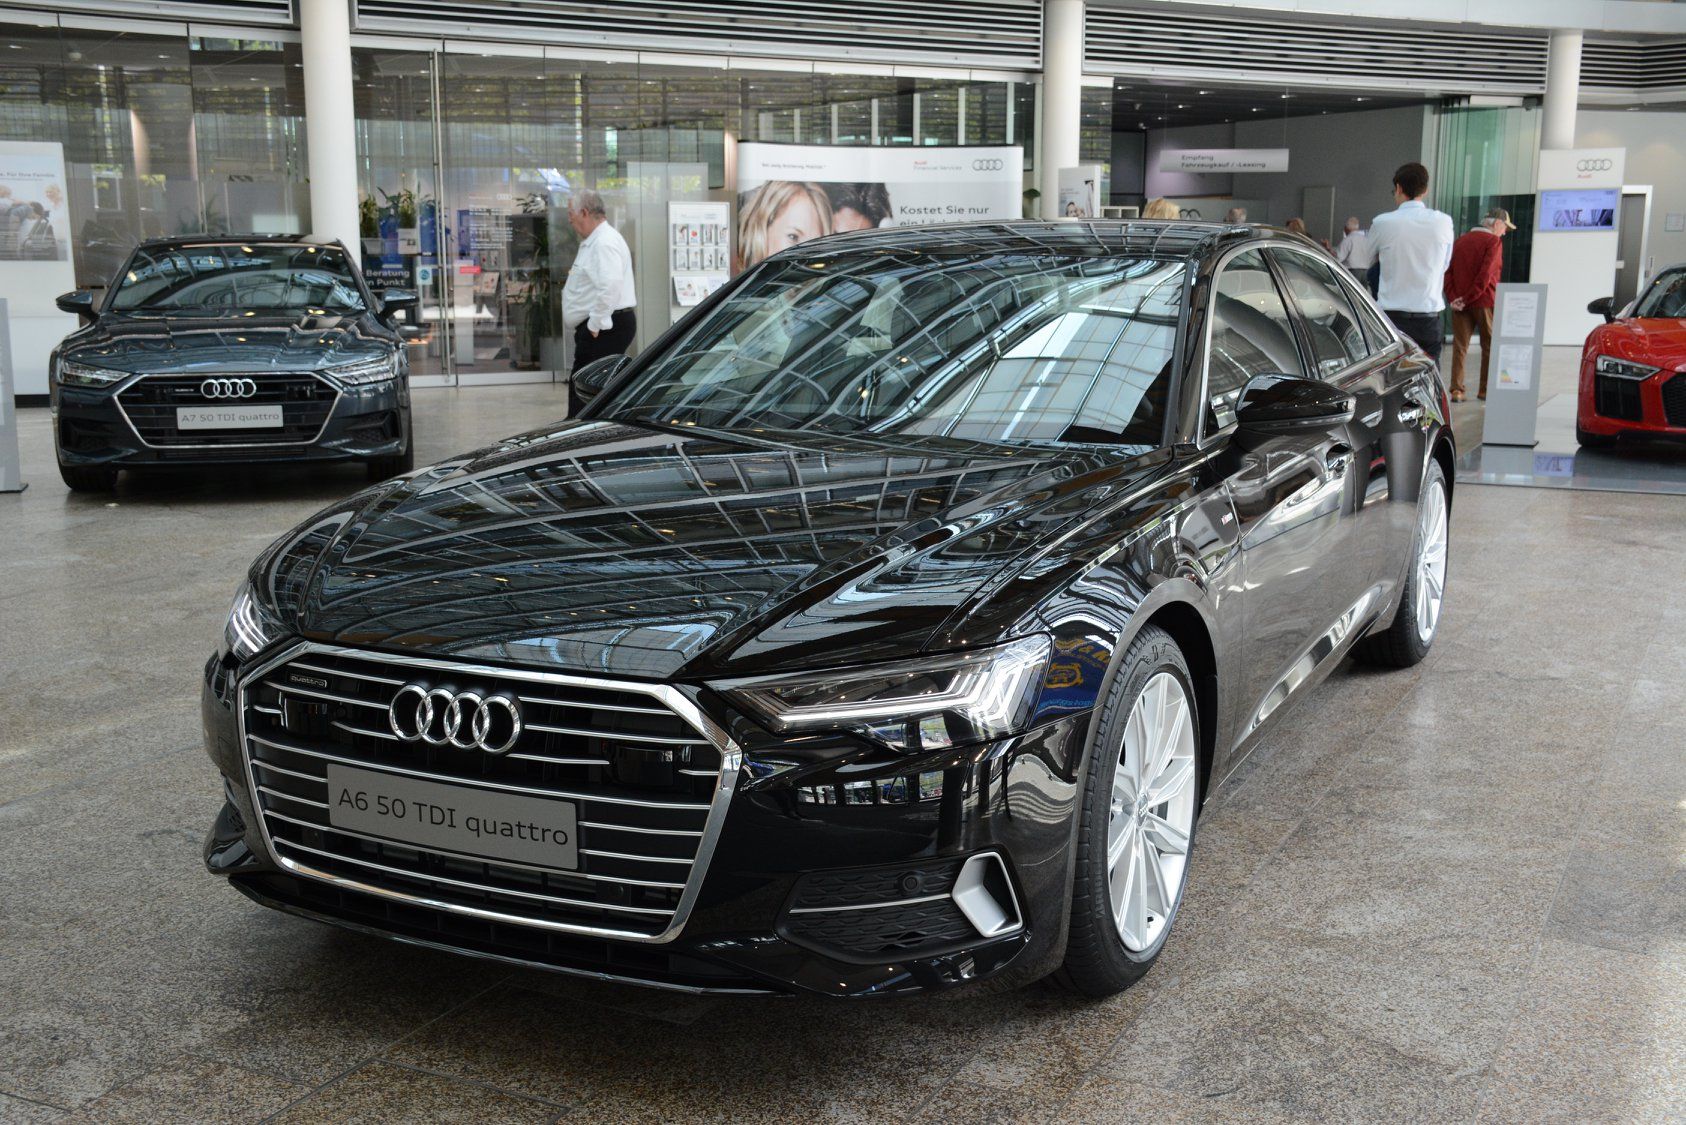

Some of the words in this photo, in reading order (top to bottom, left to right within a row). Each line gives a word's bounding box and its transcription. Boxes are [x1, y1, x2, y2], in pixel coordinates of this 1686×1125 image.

[900, 205, 942, 215] Kostet
[946, 205, 965, 215] Sie
[968, 207, 990, 215] nur
[366, 269, 411, 279] Beratung
[376, 279, 405, 287] Punkt
[181, 414, 197, 423] A7
[200, 414, 214, 423] 50
[217, 413, 236, 422] TDI
[238, 413, 280, 423] quattro
[338, 788, 369, 811] A6
[377, 795, 406, 819] 50
[413, 802, 457, 828] TDI
[466, 816, 569, 845] quattro
